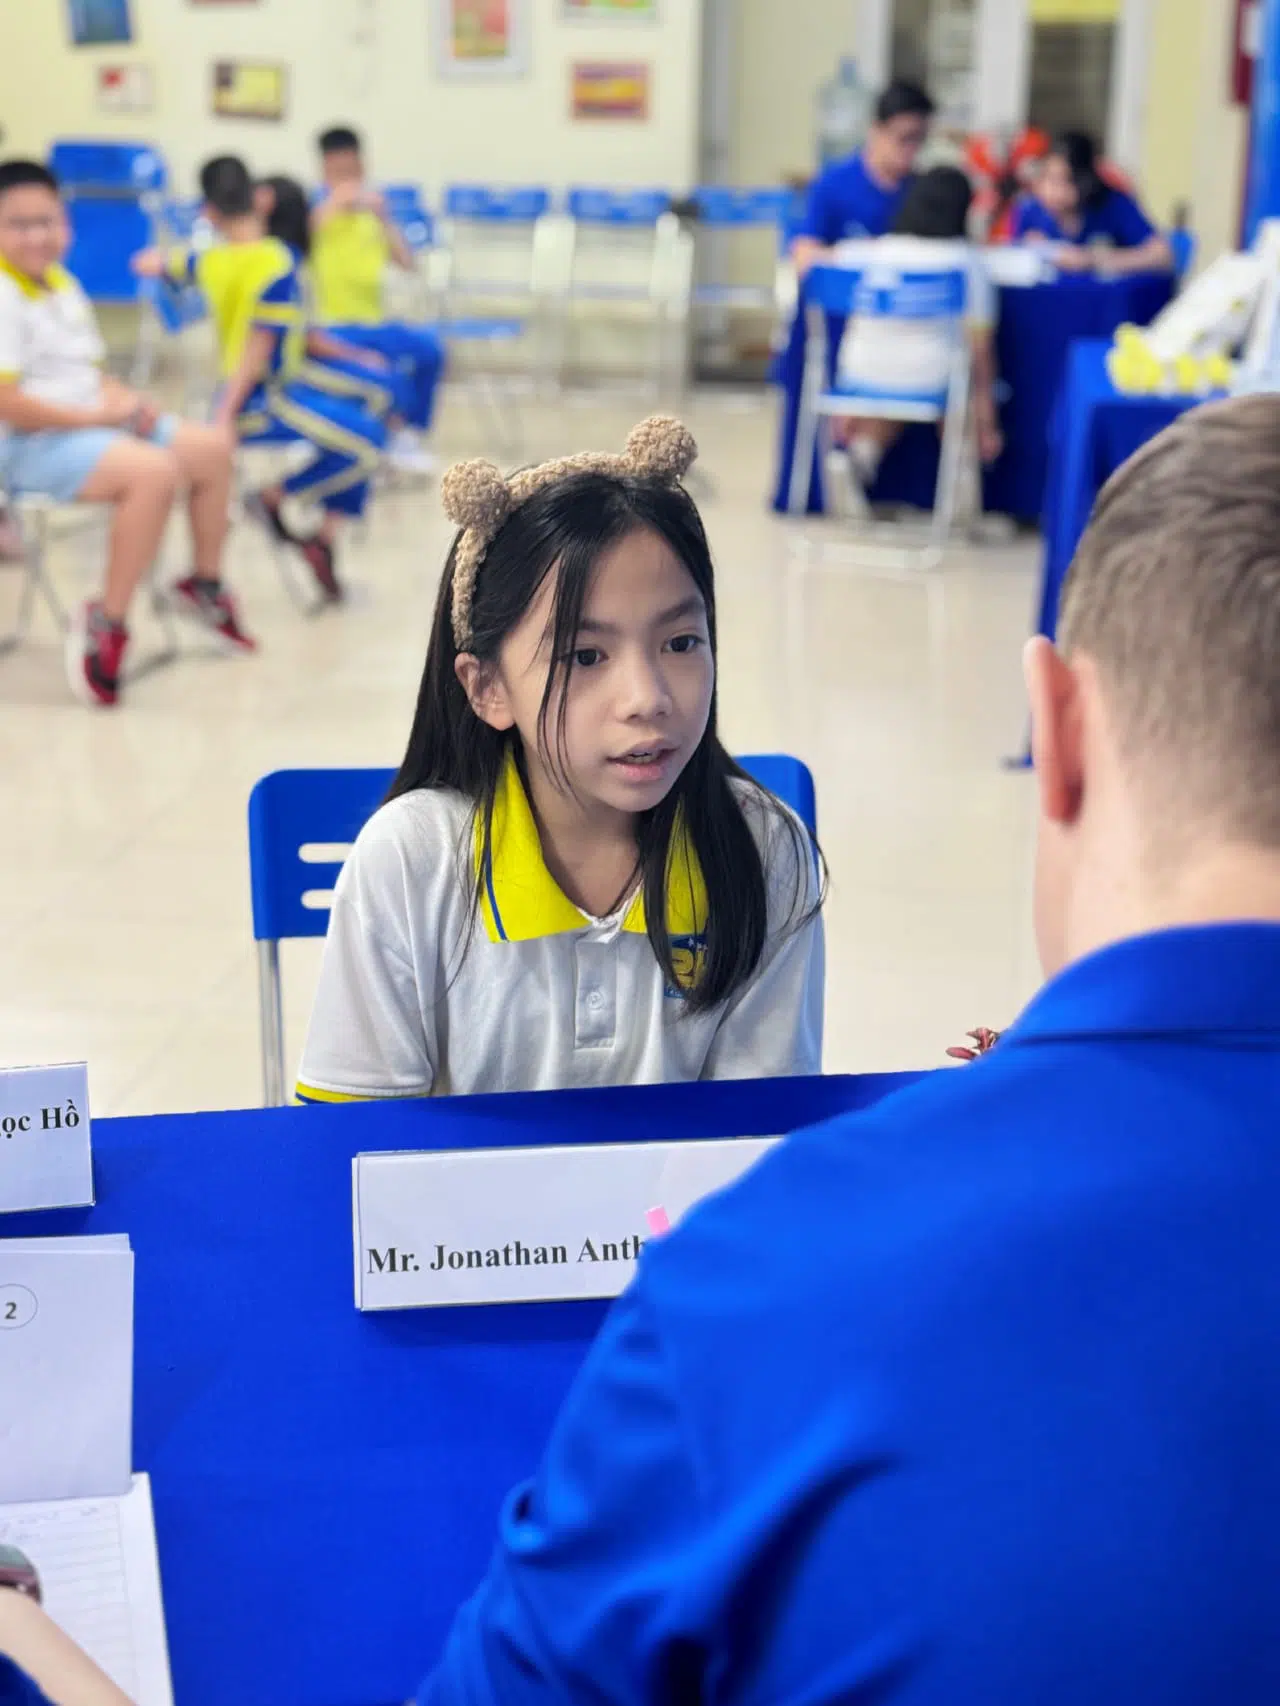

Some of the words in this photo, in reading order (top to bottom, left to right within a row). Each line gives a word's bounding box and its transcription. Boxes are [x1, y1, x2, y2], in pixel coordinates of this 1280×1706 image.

[0, 1116, 31, 1139] ọc
[40, 1098, 80, 1130] Hồ
[367, 1247, 420, 1273] Mr.
[430, 1238, 568, 1271] Jonathan
[4, 1301, 17, 1320] 2
